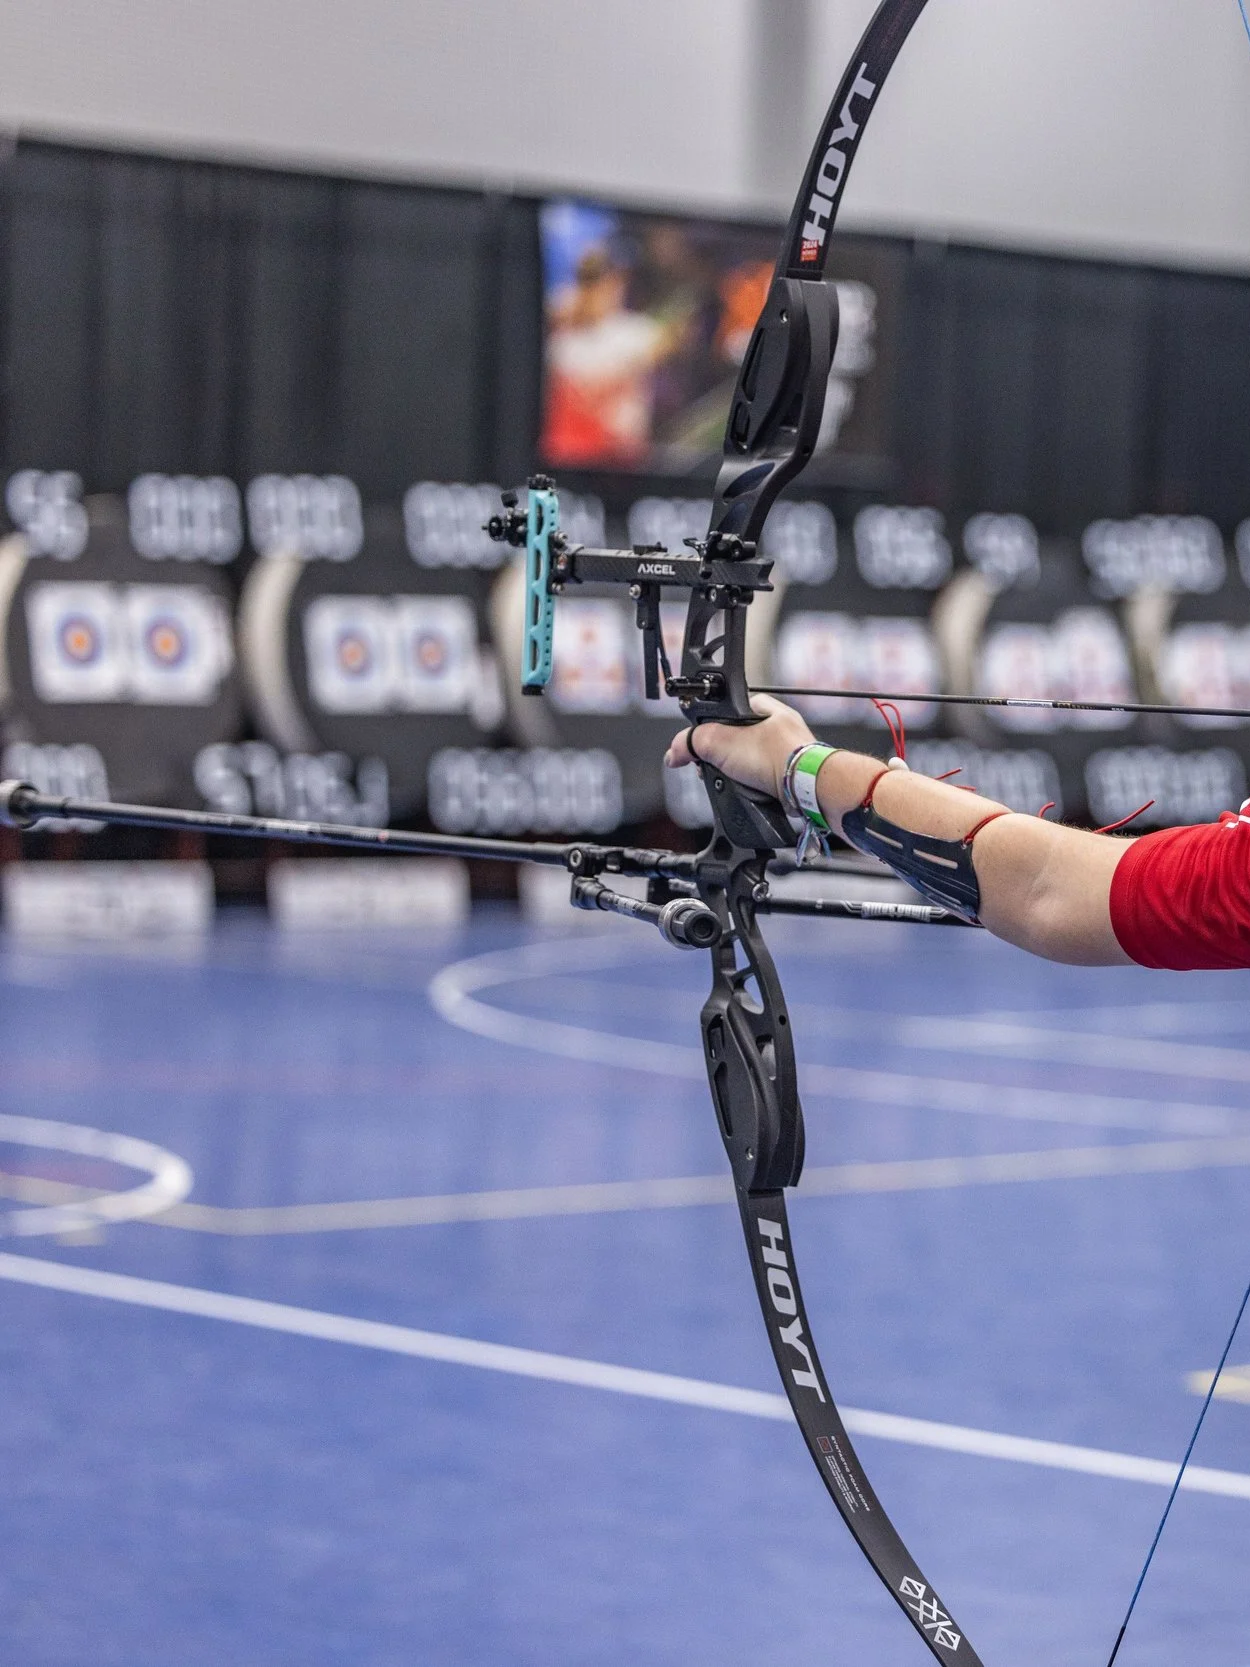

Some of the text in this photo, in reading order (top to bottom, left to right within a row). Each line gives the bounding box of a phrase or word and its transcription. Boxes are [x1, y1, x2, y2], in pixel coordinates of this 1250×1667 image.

[802, 62, 876, 246] HOYT
[637, 563, 676, 576] AXCEL
[757, 1217, 826, 1403] HOYT
